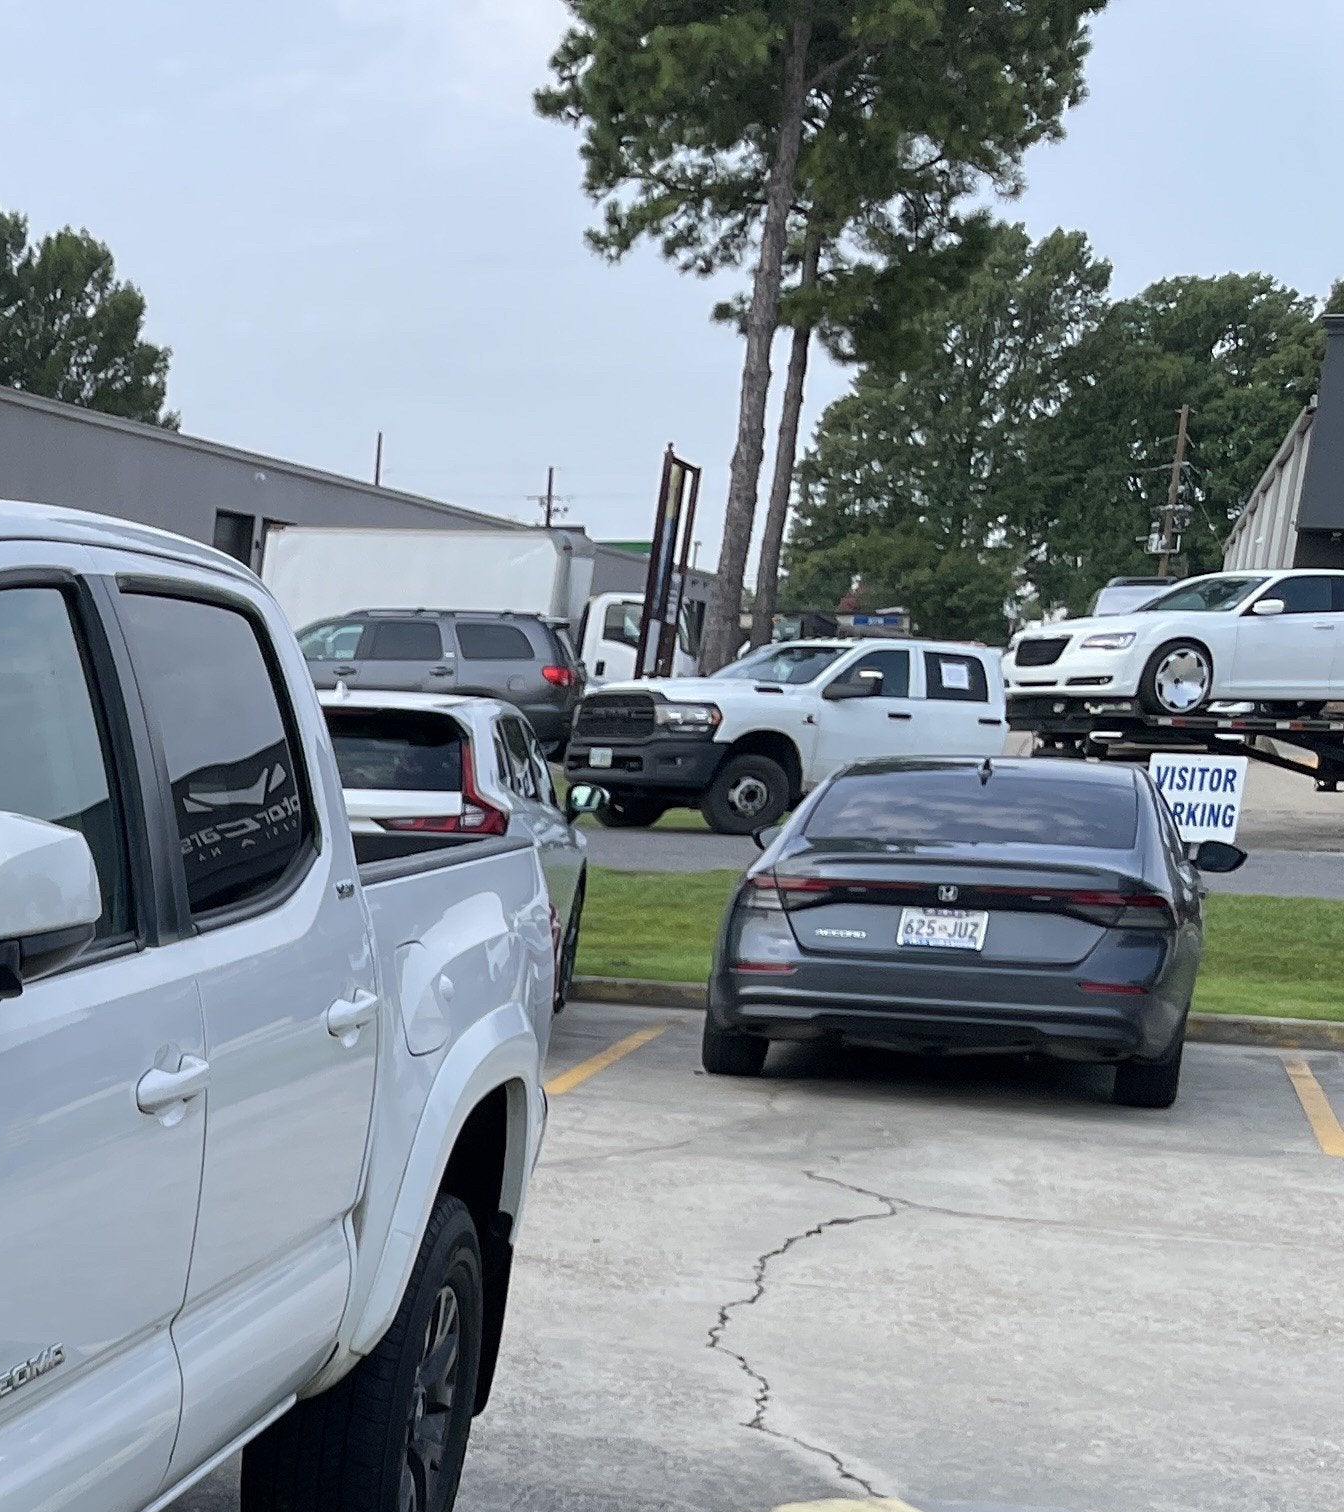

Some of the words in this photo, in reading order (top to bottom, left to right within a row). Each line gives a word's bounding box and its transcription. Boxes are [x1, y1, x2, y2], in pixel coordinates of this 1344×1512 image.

[1156, 765, 1237, 792] VISITOR
[1172, 802, 1236, 828] RKING
[905, 919, 936, 937] 625
